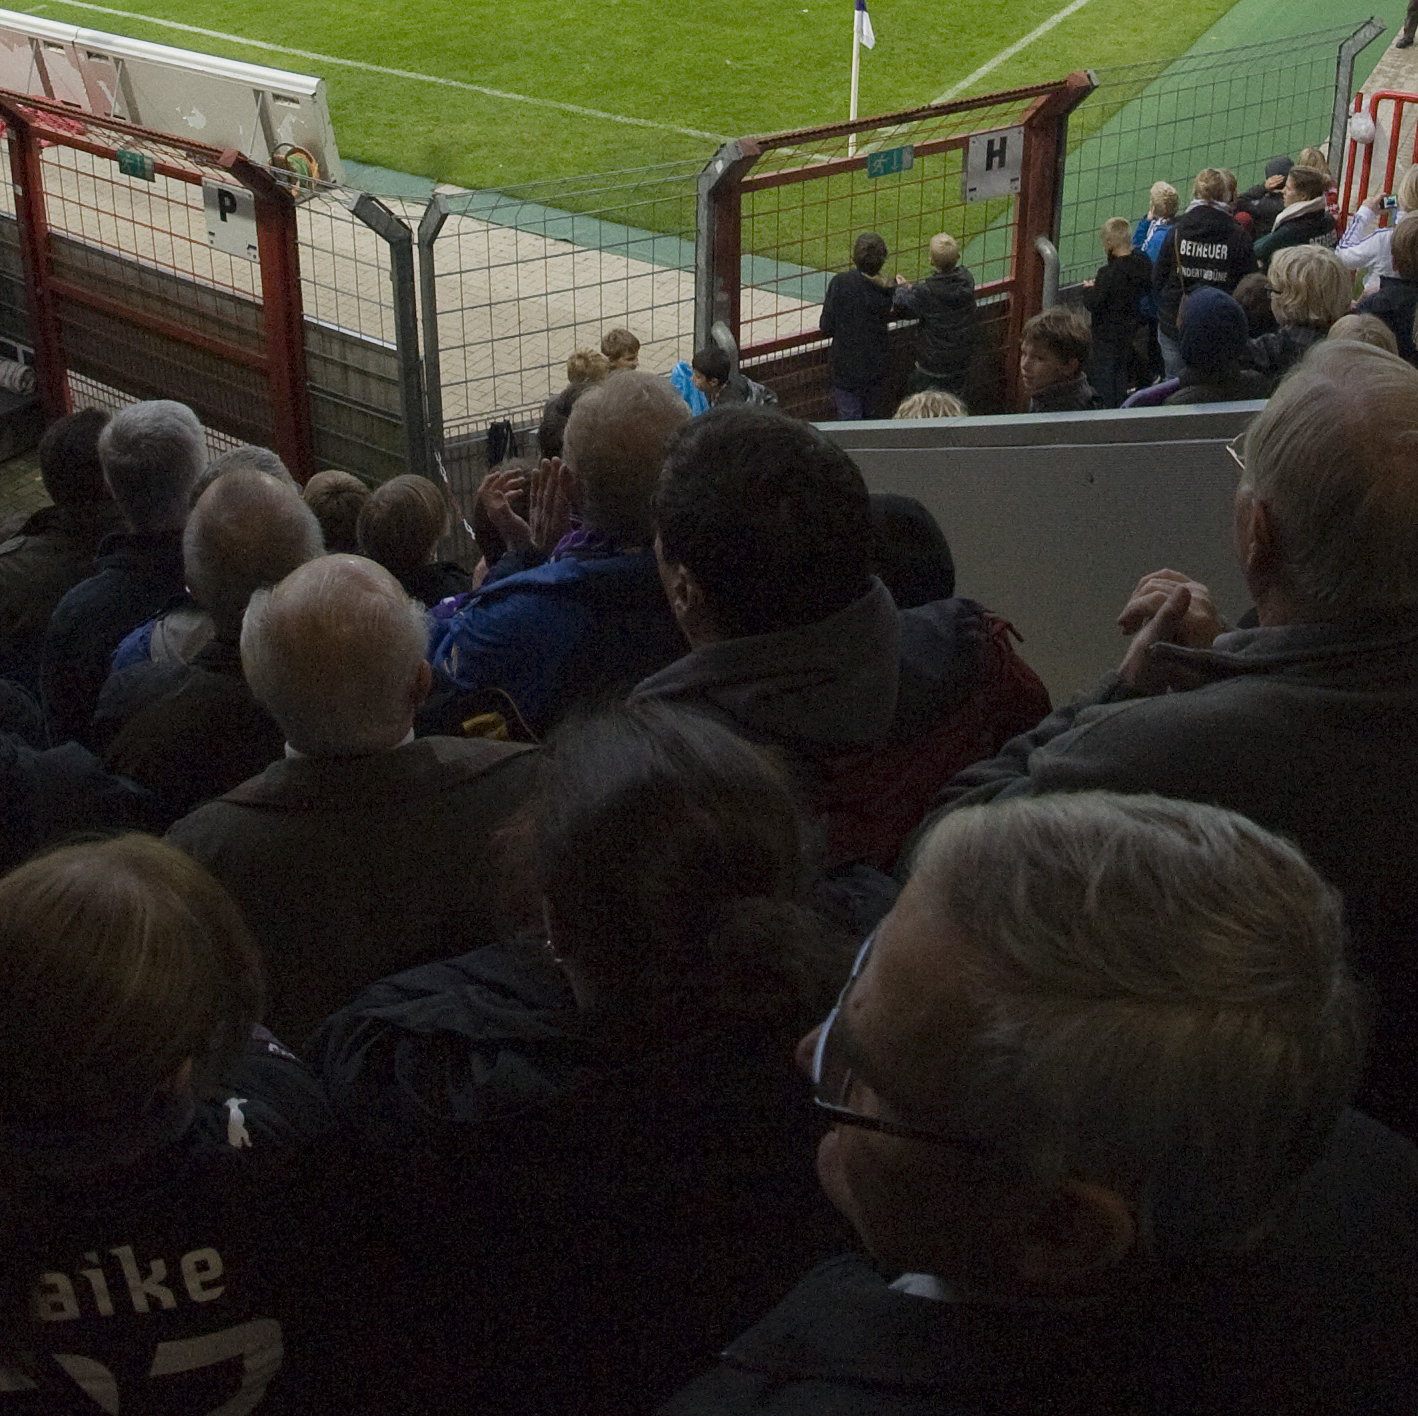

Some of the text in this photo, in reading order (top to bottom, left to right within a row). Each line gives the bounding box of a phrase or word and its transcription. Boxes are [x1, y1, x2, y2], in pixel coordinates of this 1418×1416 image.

[986, 136, 1007, 172] H
[218, 188, 237, 223] P
[1180, 240, 1228, 260] BETREUER
